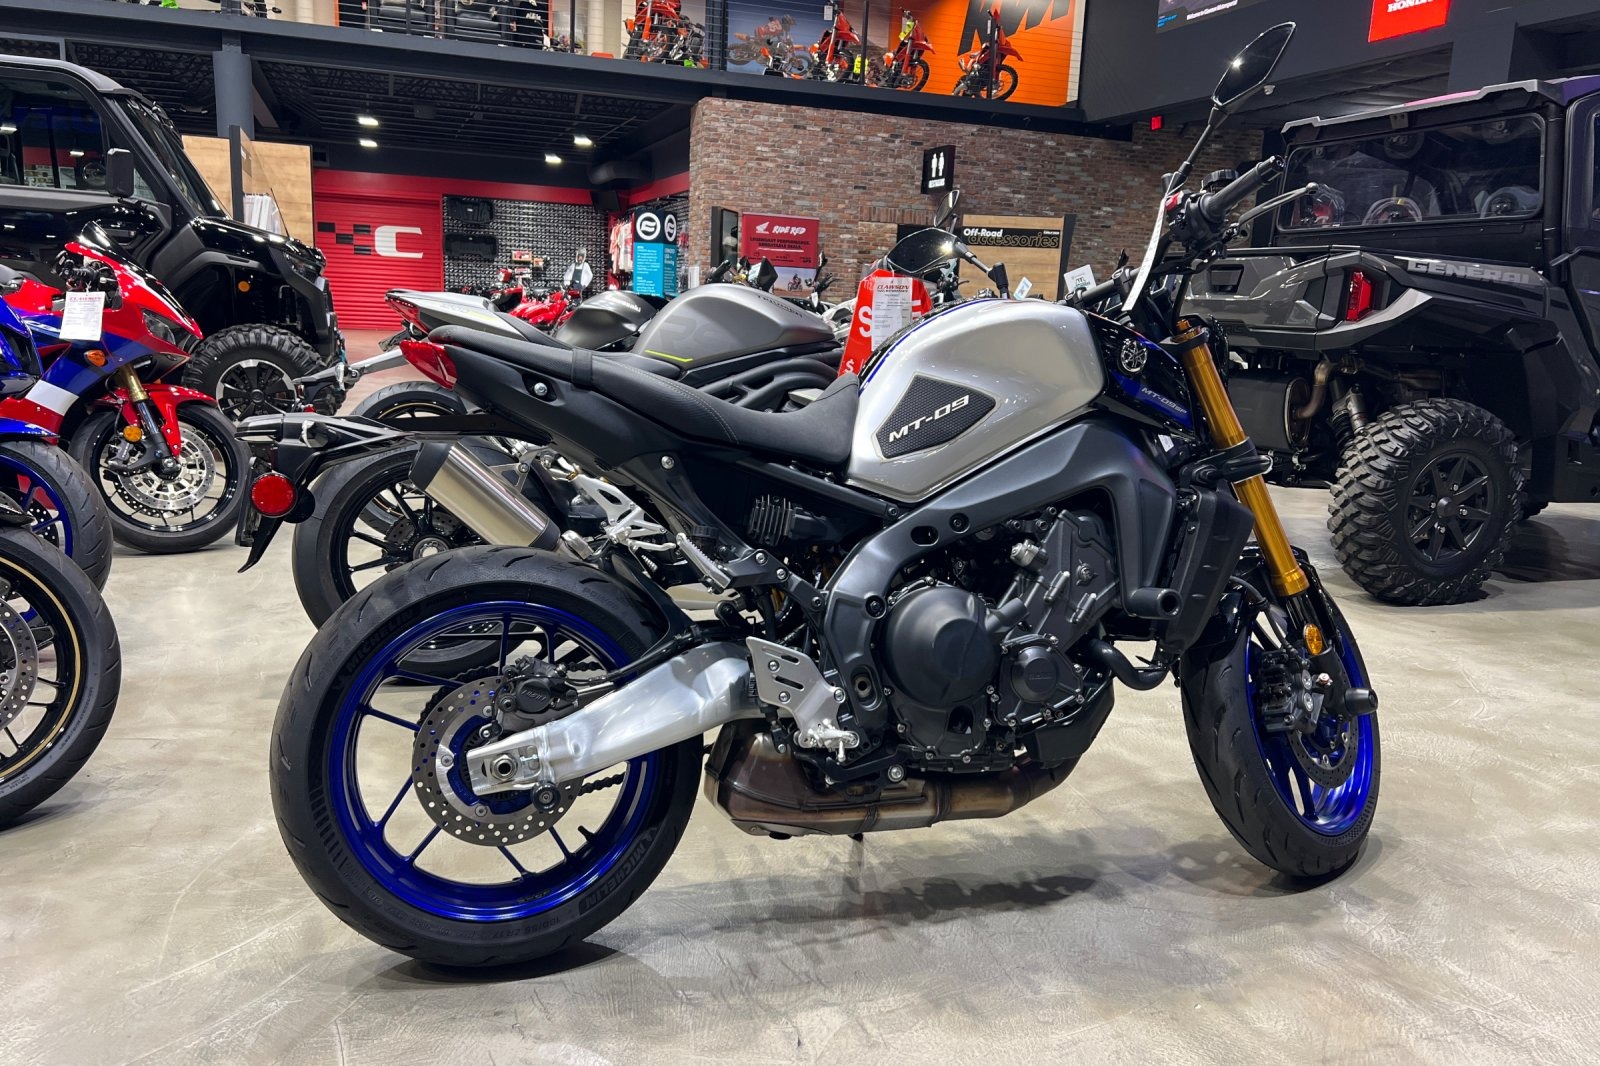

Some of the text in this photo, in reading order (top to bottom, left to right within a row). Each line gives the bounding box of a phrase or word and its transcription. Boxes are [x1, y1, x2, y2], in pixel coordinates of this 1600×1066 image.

[772, 225, 807, 236] RIDE RED
[963, 228, 1004, 237] Off-Road
[968, 232, 1059, 248] accessories
[888, 394, 970, 442] MT-09
[584, 842, 646, 909] MICHELIN
